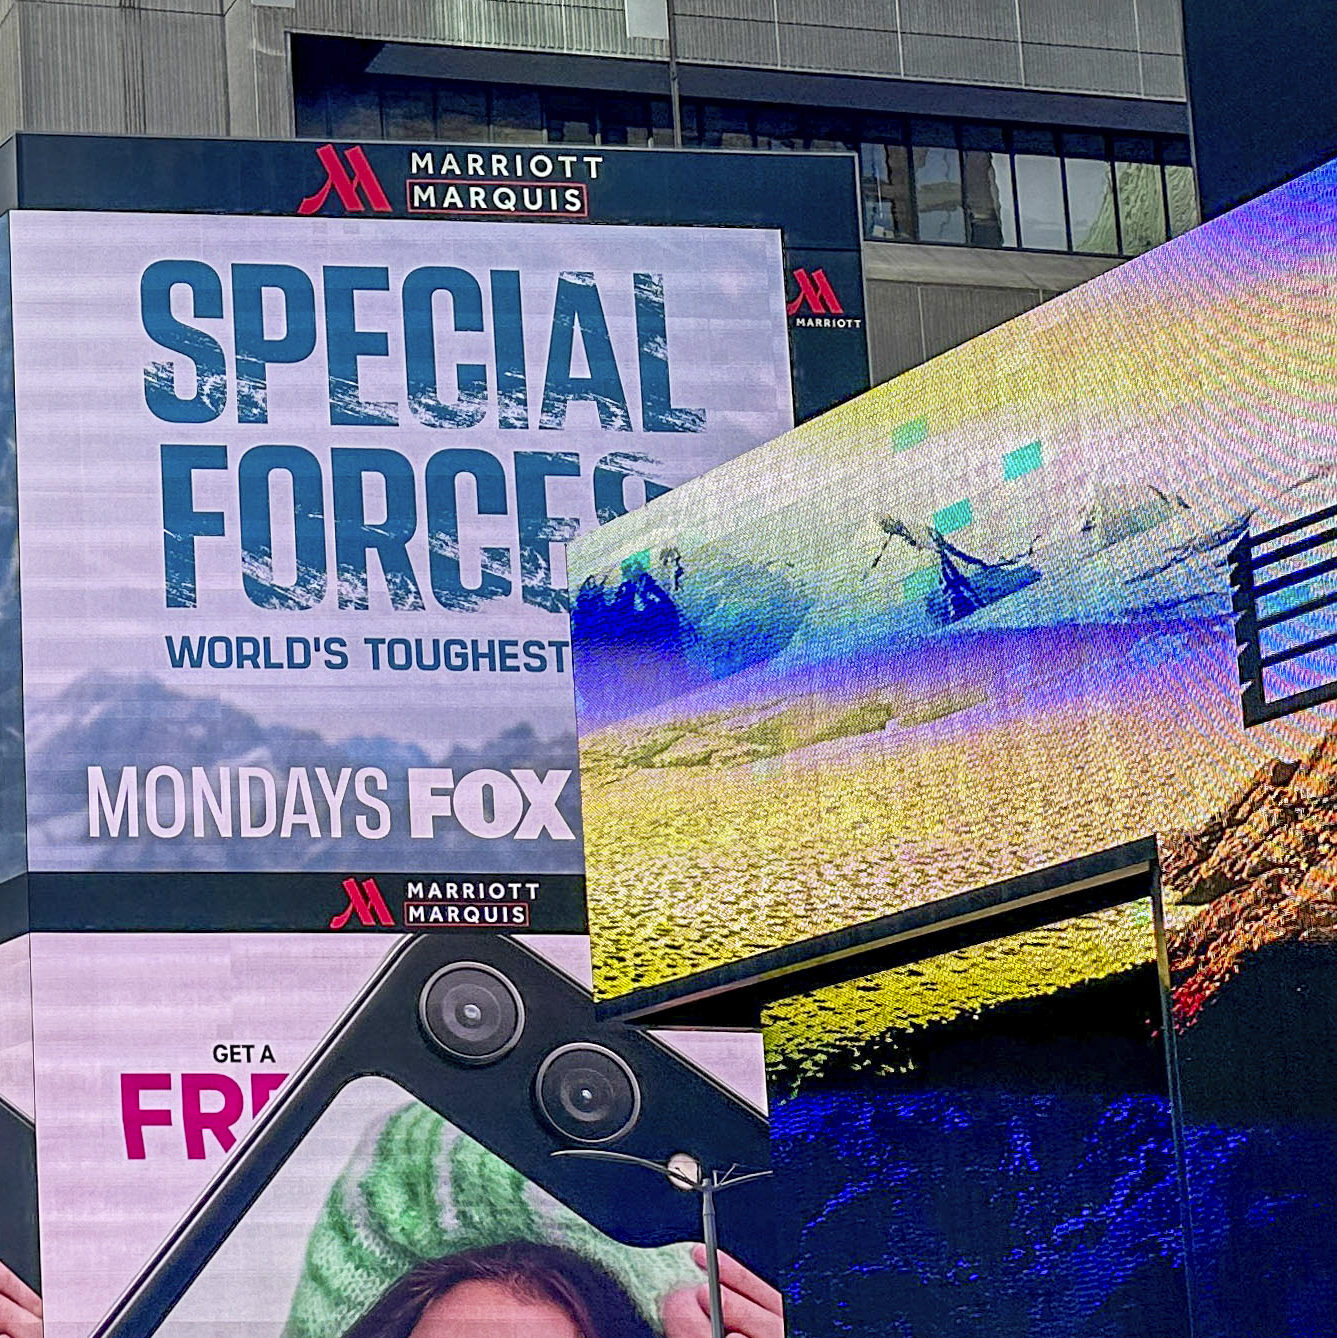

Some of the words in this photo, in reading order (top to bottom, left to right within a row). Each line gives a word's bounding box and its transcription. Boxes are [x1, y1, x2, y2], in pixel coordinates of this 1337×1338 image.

[410, 150, 603, 180] MARRIOTT
[411, 182, 585, 213] MARQUIS
[795, 316, 863, 329] MARRIOTT
[140, 259, 707, 433] SPECIAL
[166, 634, 348, 671] WORLD'S
[364, 637, 571, 674] TOUGHEST
[87, 764, 392, 840] MONDAYS
[408, 768, 577, 841] FOX
[407, 881, 540, 901] MARRIOTT
[407, 905, 527, 925] MARQUIS
[212, 1044, 256, 1064] GET
[259, 1044, 277, 1063] A
